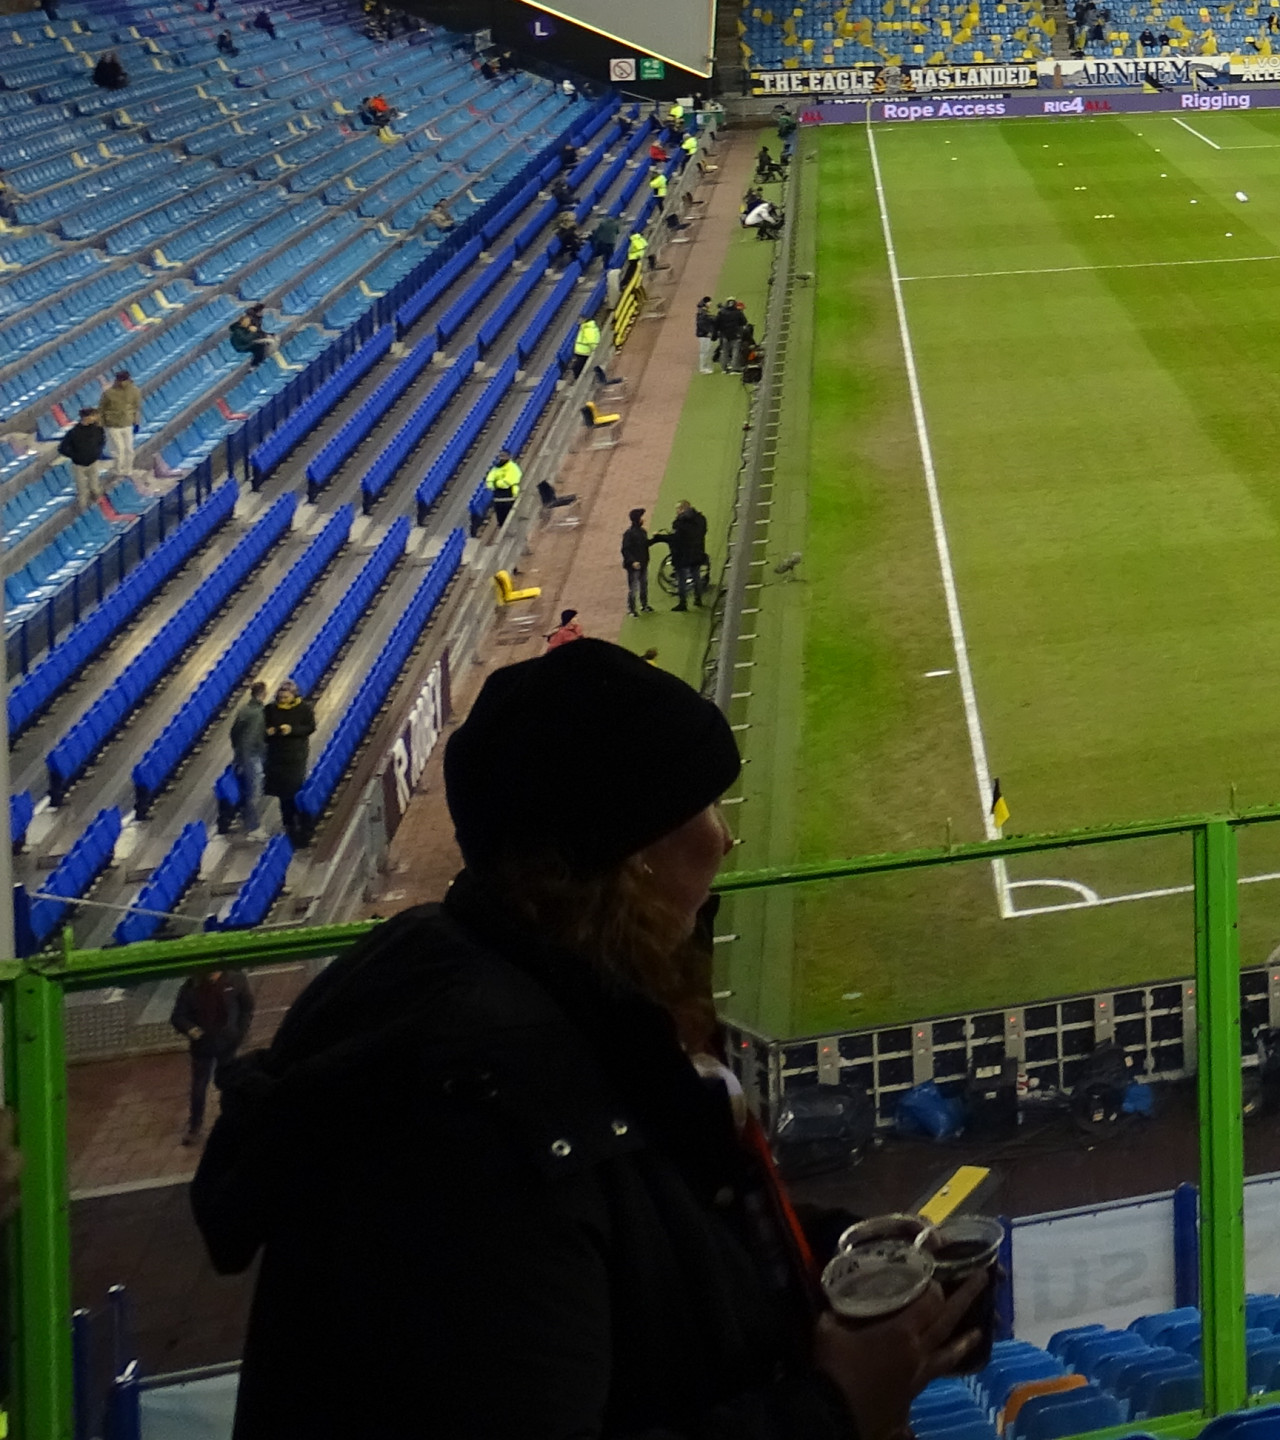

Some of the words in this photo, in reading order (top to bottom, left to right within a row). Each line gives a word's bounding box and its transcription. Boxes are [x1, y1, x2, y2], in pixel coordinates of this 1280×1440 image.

[535, 22, 549, 36] L
[759, 73, 801, 93] THE
[808, 70, 875, 92] EAGLE
[909, 67, 949, 89] HAS
[954, 65, 1031, 87] LANDED
[1076, 60, 1190, 86] ARNHEM
[883, 103, 935, 121] Rope
[939, 101, 1006, 117] Access
[1181, 92, 1250, 110] Rigging
